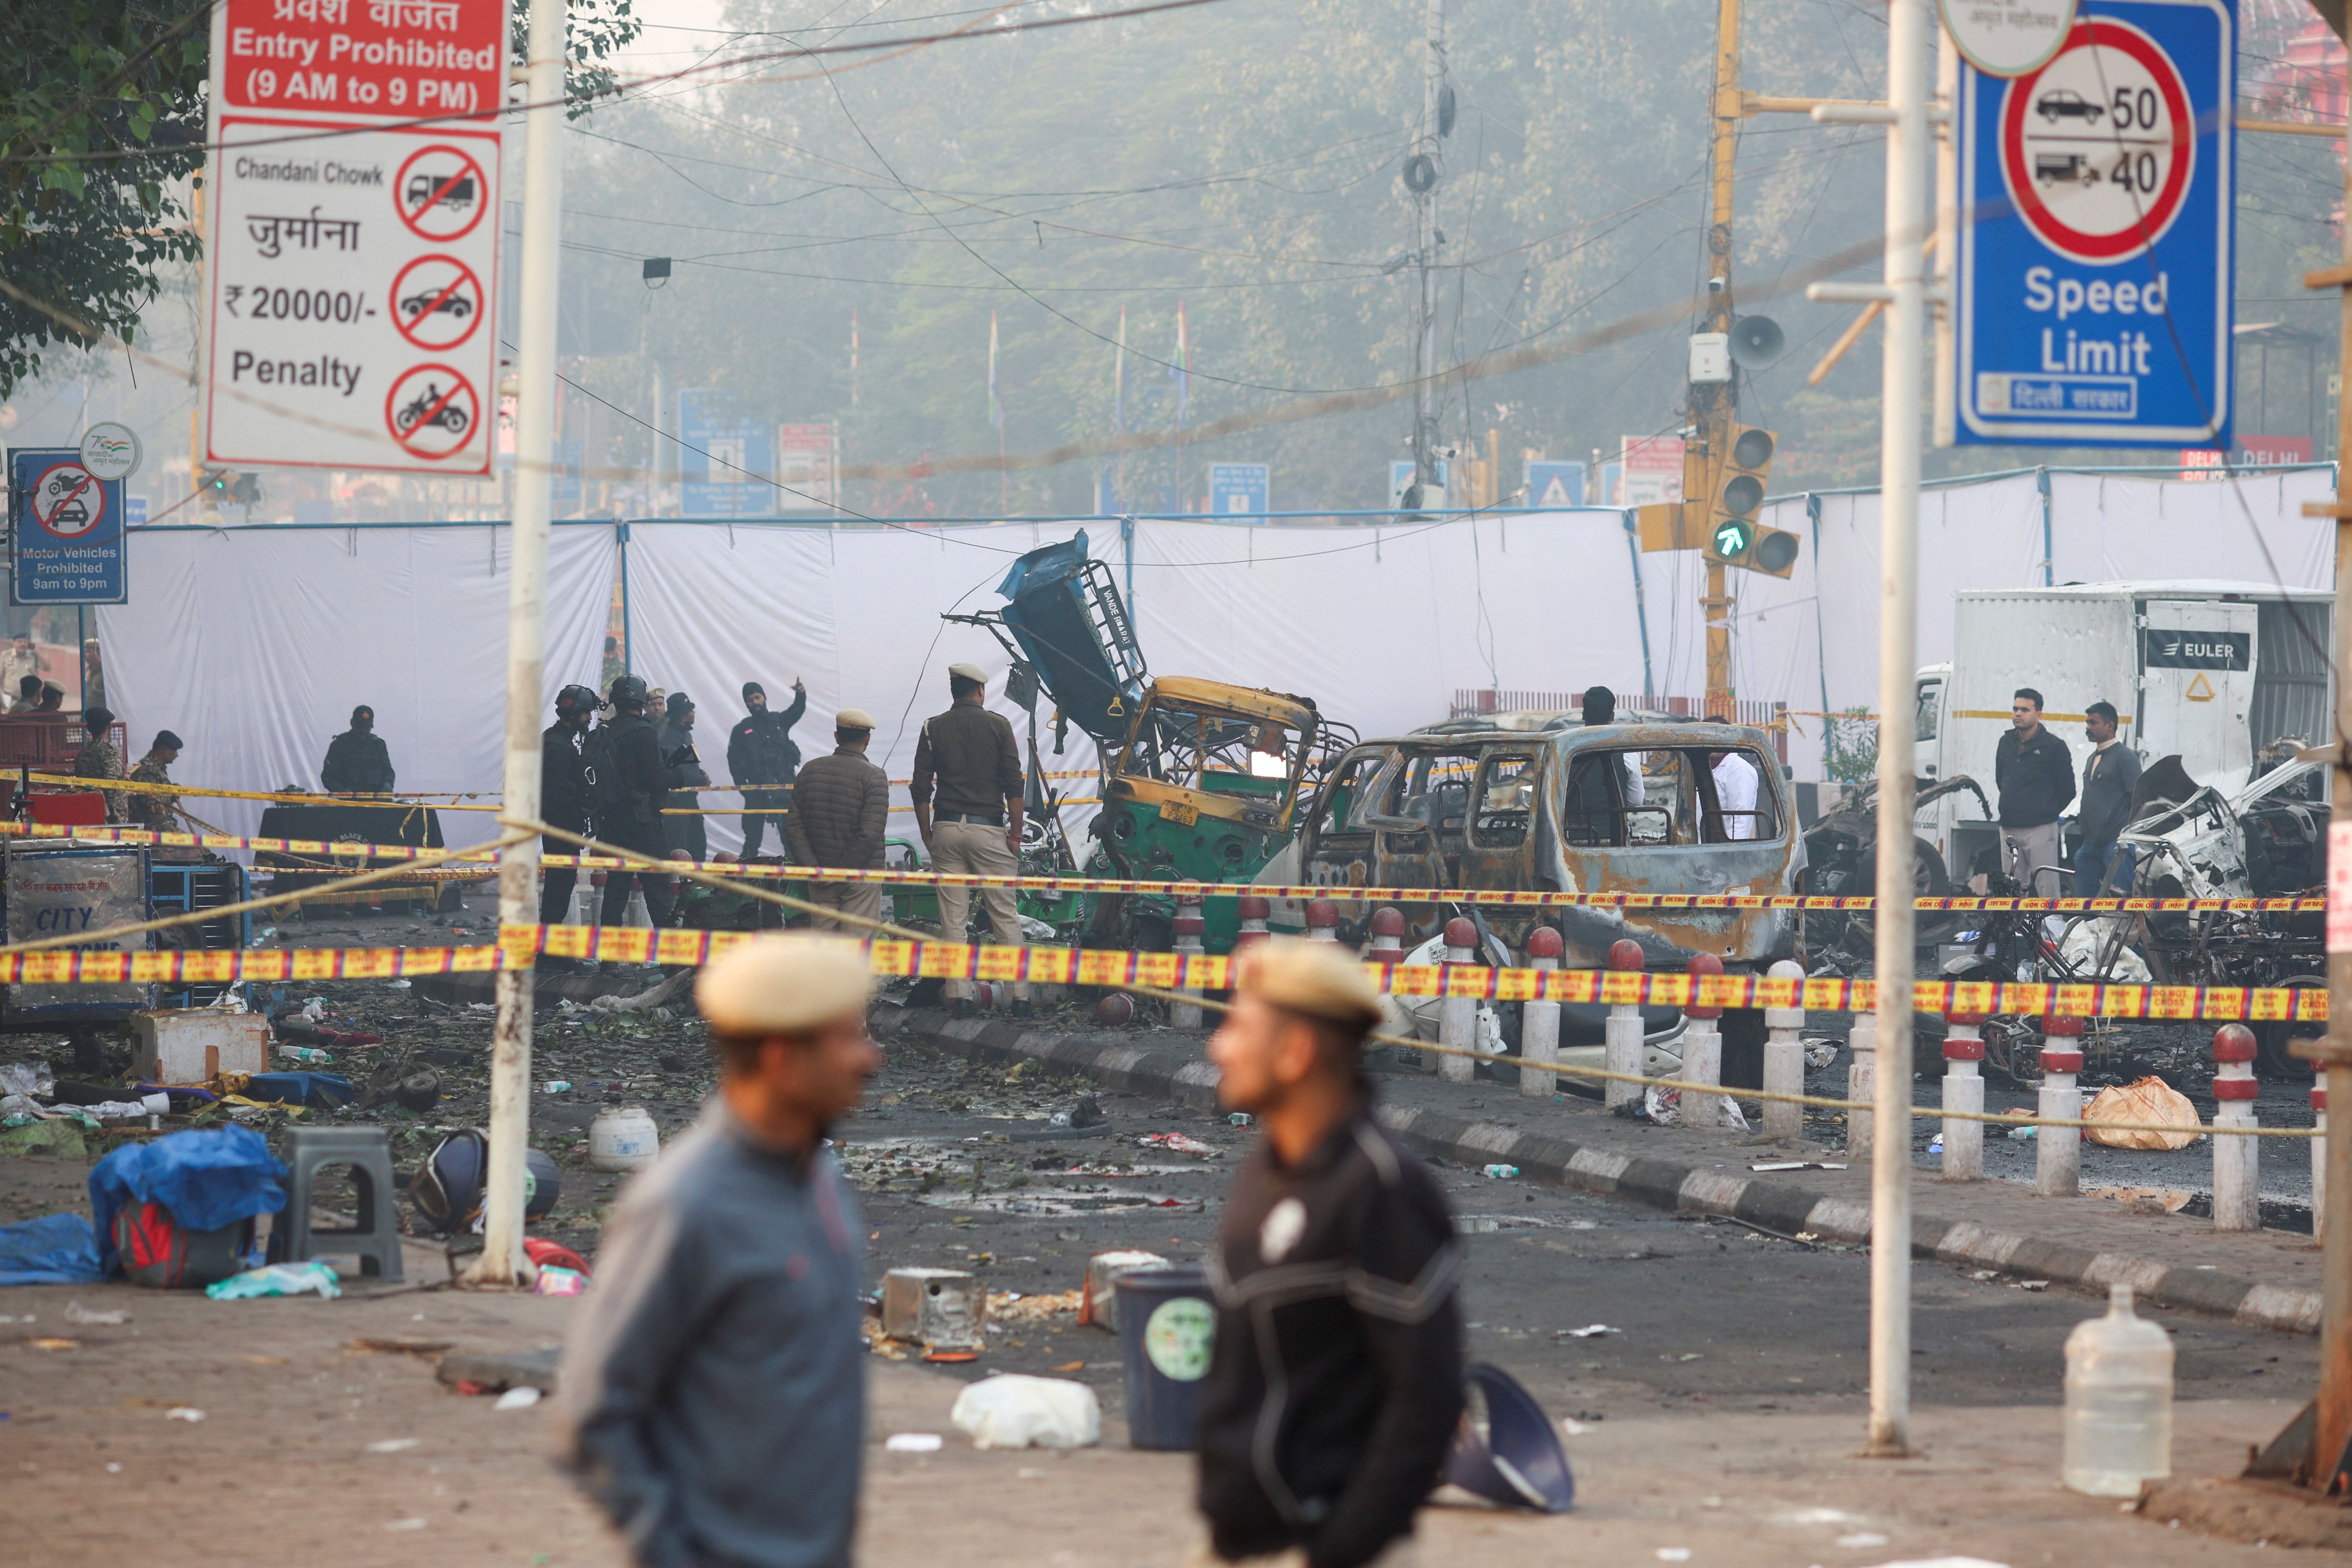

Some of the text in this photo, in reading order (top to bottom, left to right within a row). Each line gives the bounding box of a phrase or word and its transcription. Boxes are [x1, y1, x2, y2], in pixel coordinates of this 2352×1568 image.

[233, 28, 495, 71] Entry Prohibited
[247, 68, 479, 112] (9 AM to 9 PM)
[2113, 87, 2157, 130] 50
[236, 158, 384, 187] Chandani Chowk
[2112, 151, 2157, 193] 40
[246, 206, 360, 258] जुर्माना
[2024, 266, 2169, 320] Speed
[2042, 328, 2152, 375] Limit
[232, 351, 362, 397] Penalty
[2243, 449, 2299, 465] DELHI
[23, 547, 116, 558] Motor Vehicles
[37, 563, 102, 574] Prohibited
[33, 578, 106, 591] 9am to 9pm
[1103, 588, 1132, 645] VANDE BARAT
[2184, 643, 2234, 659] EULER
[37, 907, 92, 931] CITY
[1913, 999, 1941, 1007] OLICE
[2152, 989, 2187, 998] DO NOT
[2154, 998, 2185, 1006] CROSS
[2210, 993, 2236, 1001] DELHI
[2205, 1006, 2239, 1015] POLICE
[2302, 1001, 2328, 1009] CROS
